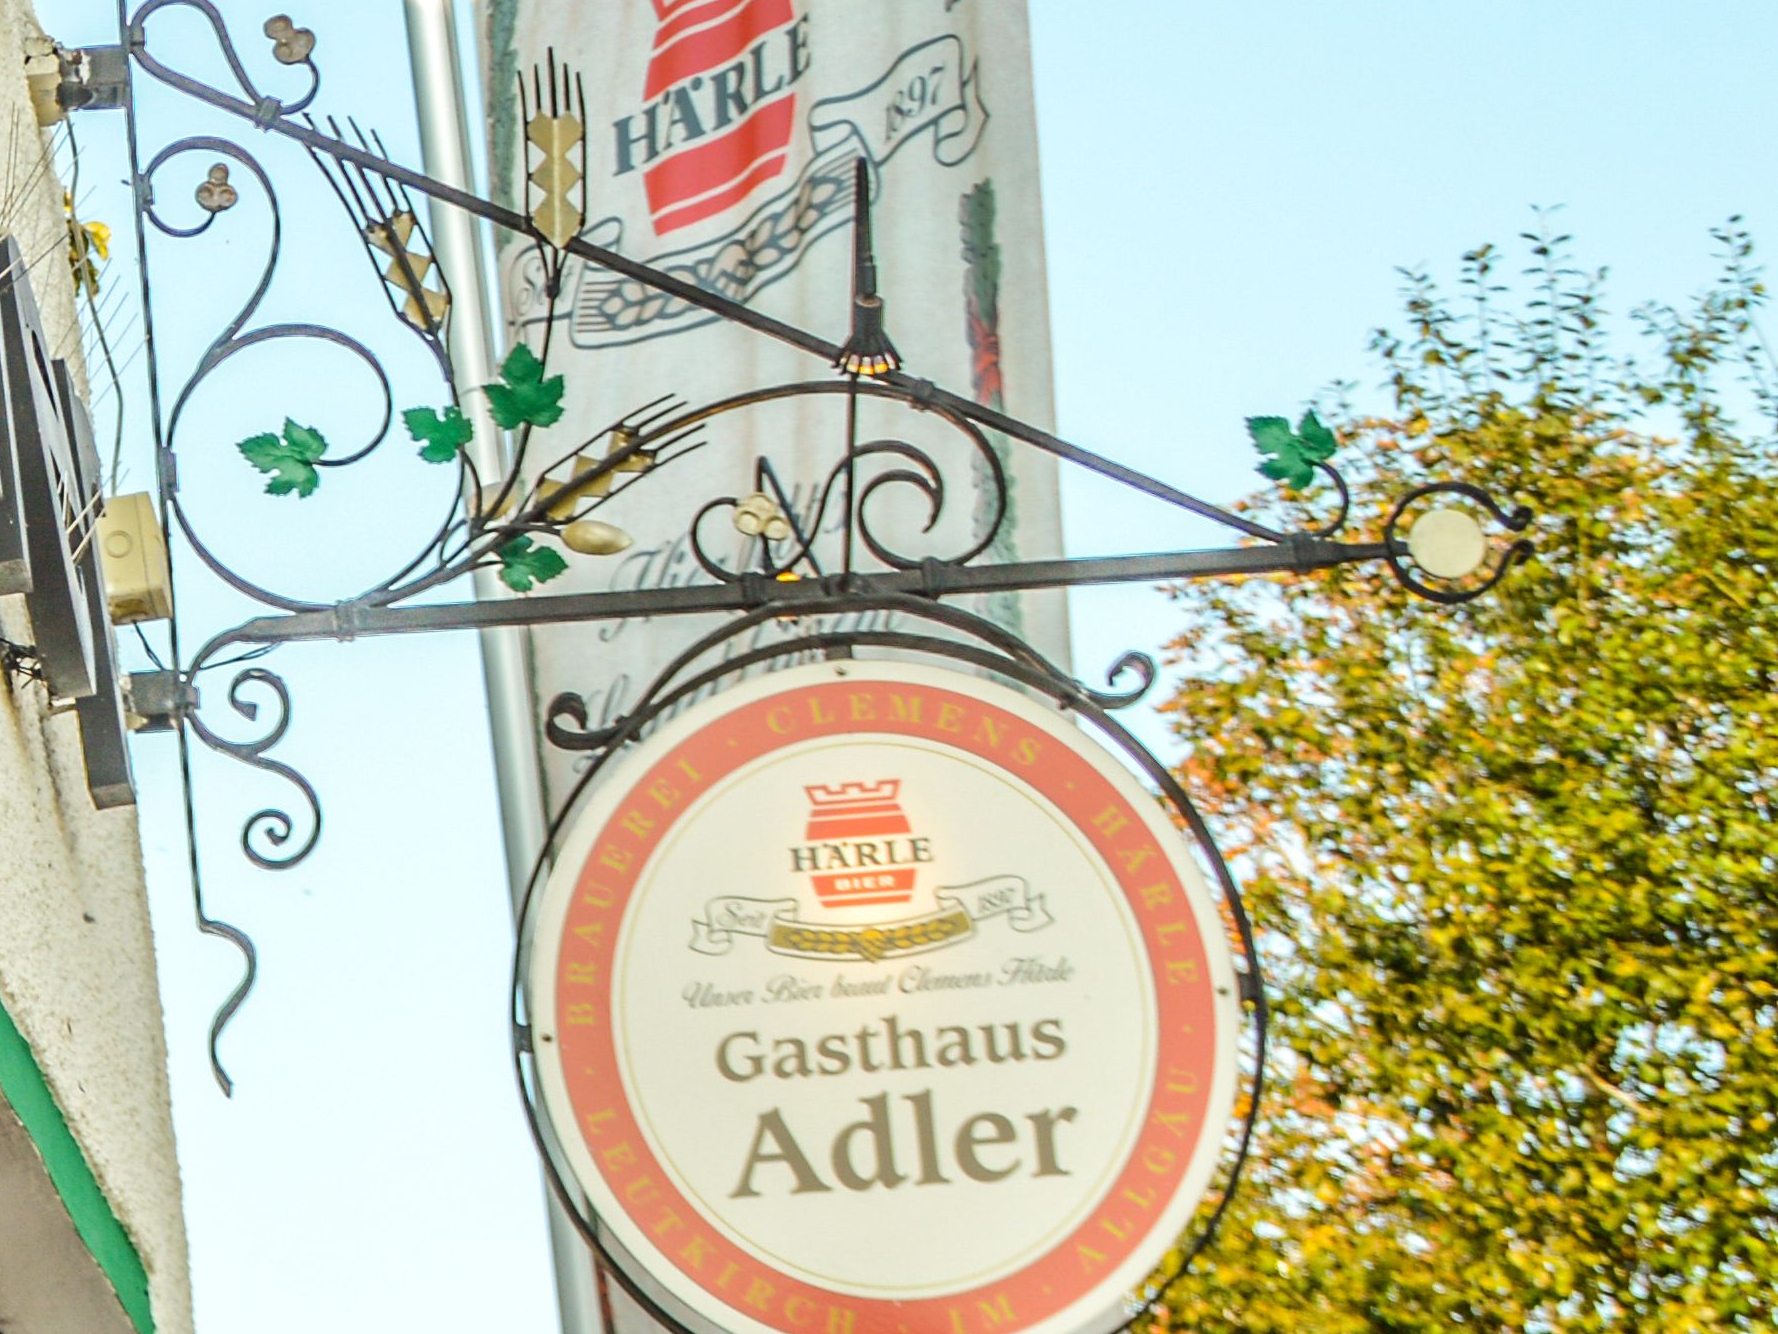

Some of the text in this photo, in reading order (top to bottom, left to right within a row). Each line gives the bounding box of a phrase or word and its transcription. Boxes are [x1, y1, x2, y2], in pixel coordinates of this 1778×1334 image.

[612, 12, 811, 177] HÄRLE
[884, 65, 946, 144] 1897
[565, 691, 1201, 1027] BRAUEREI CLEMENS HÄRLE
[789, 836, 934, 873] HÄRLE
[834, 873, 897, 892] BIER
[681, 979, 756, 1010] Unser
[761, 974, 825, 1004] Bier
[898, 965, 994, 995] Clemens
[716, 1015, 1068, 1084] Gasthaus
[728, 1089, 1080, 1199] Adler
[1075, 1066, 1201, 1277] ALLGÄU
